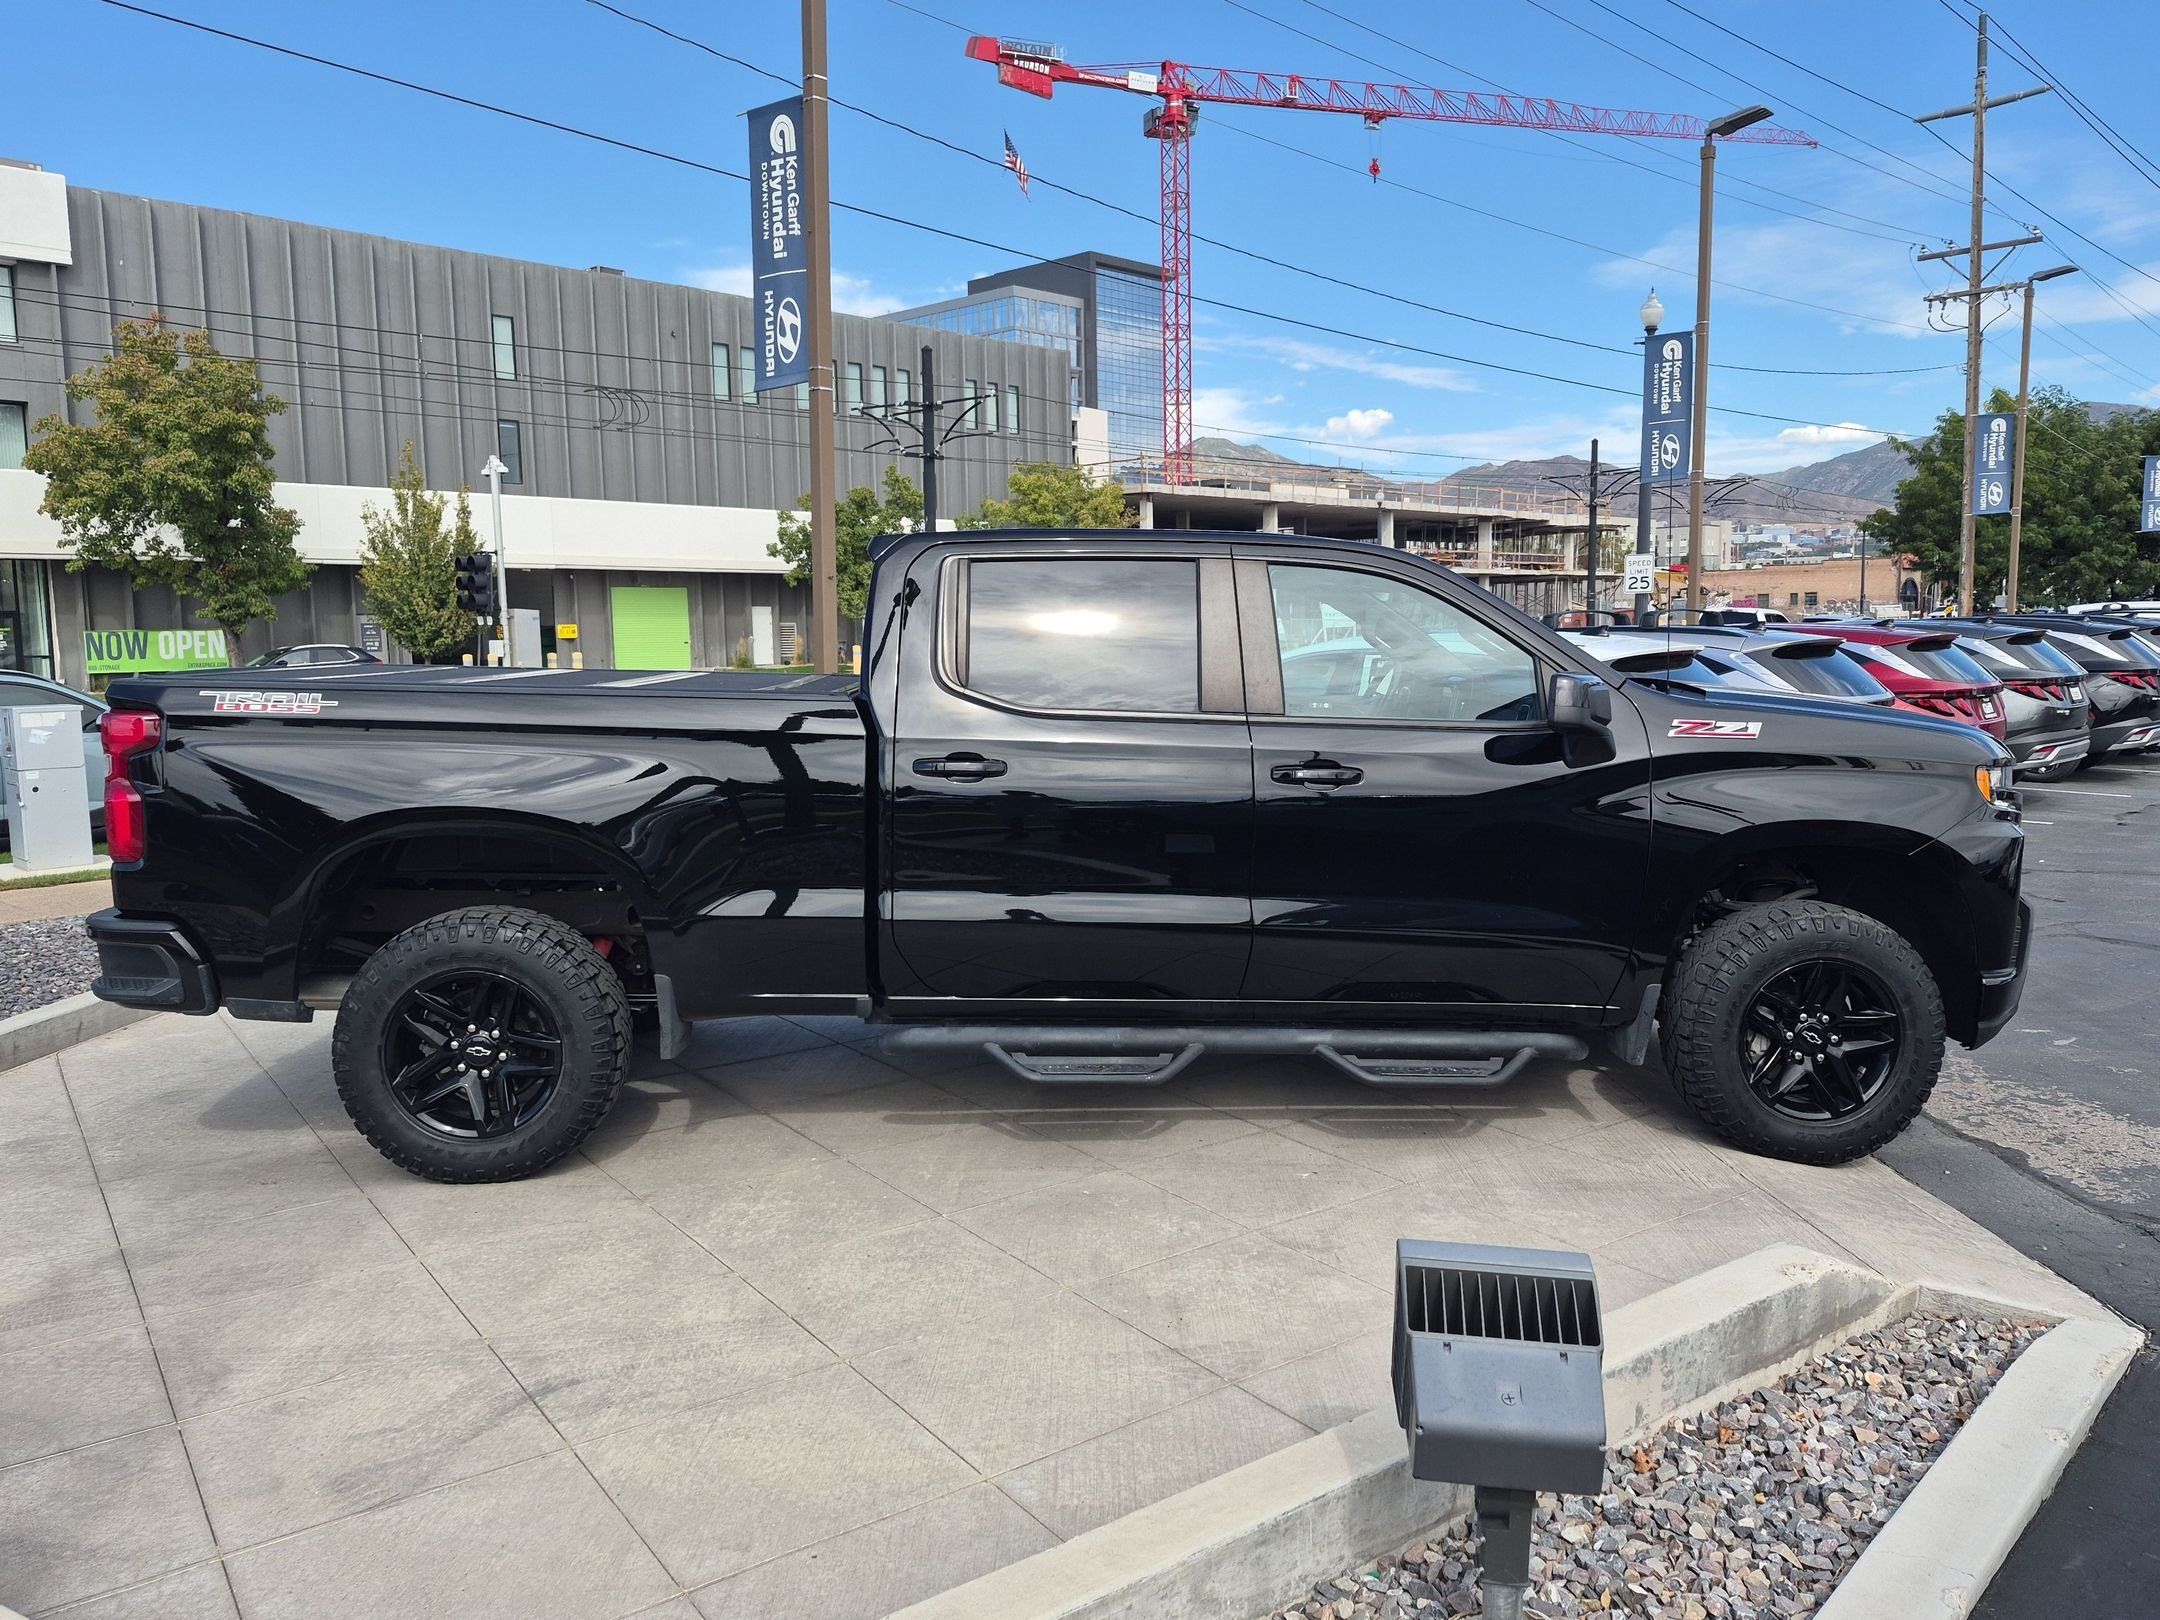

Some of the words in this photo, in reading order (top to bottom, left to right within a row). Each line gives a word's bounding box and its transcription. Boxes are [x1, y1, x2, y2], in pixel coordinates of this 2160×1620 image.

[785, 155, 798, 191] Ken
[761, 162, 770, 240] DOWNTOWN
[769, 157, 788, 260] Hyundai
[787, 192, 801, 236] Garff
[764, 290, 775, 377] HYUNDAI
[1652, 363, 1660, 405] DOWNTOWN
[1672, 361, 1683, 379] Ken
[1660, 362, 1673, 415] Hyundai
[1672, 379, 1682, 402] Garff
[1651, 430, 1660, 477] HYUNDAI
[1988, 432, 1999, 469] Hyundai
[1980, 478, 1988, 511] HYUNDAI
[1628, 576, 1650, 590] 25
[85, 631, 148, 661] NOW
[158, 630, 228, 660] OPEN
[199, 690, 339, 706] TRAIL
[214, 702, 321, 714] BOSS
[1667, 719, 1762, 739] Z71
